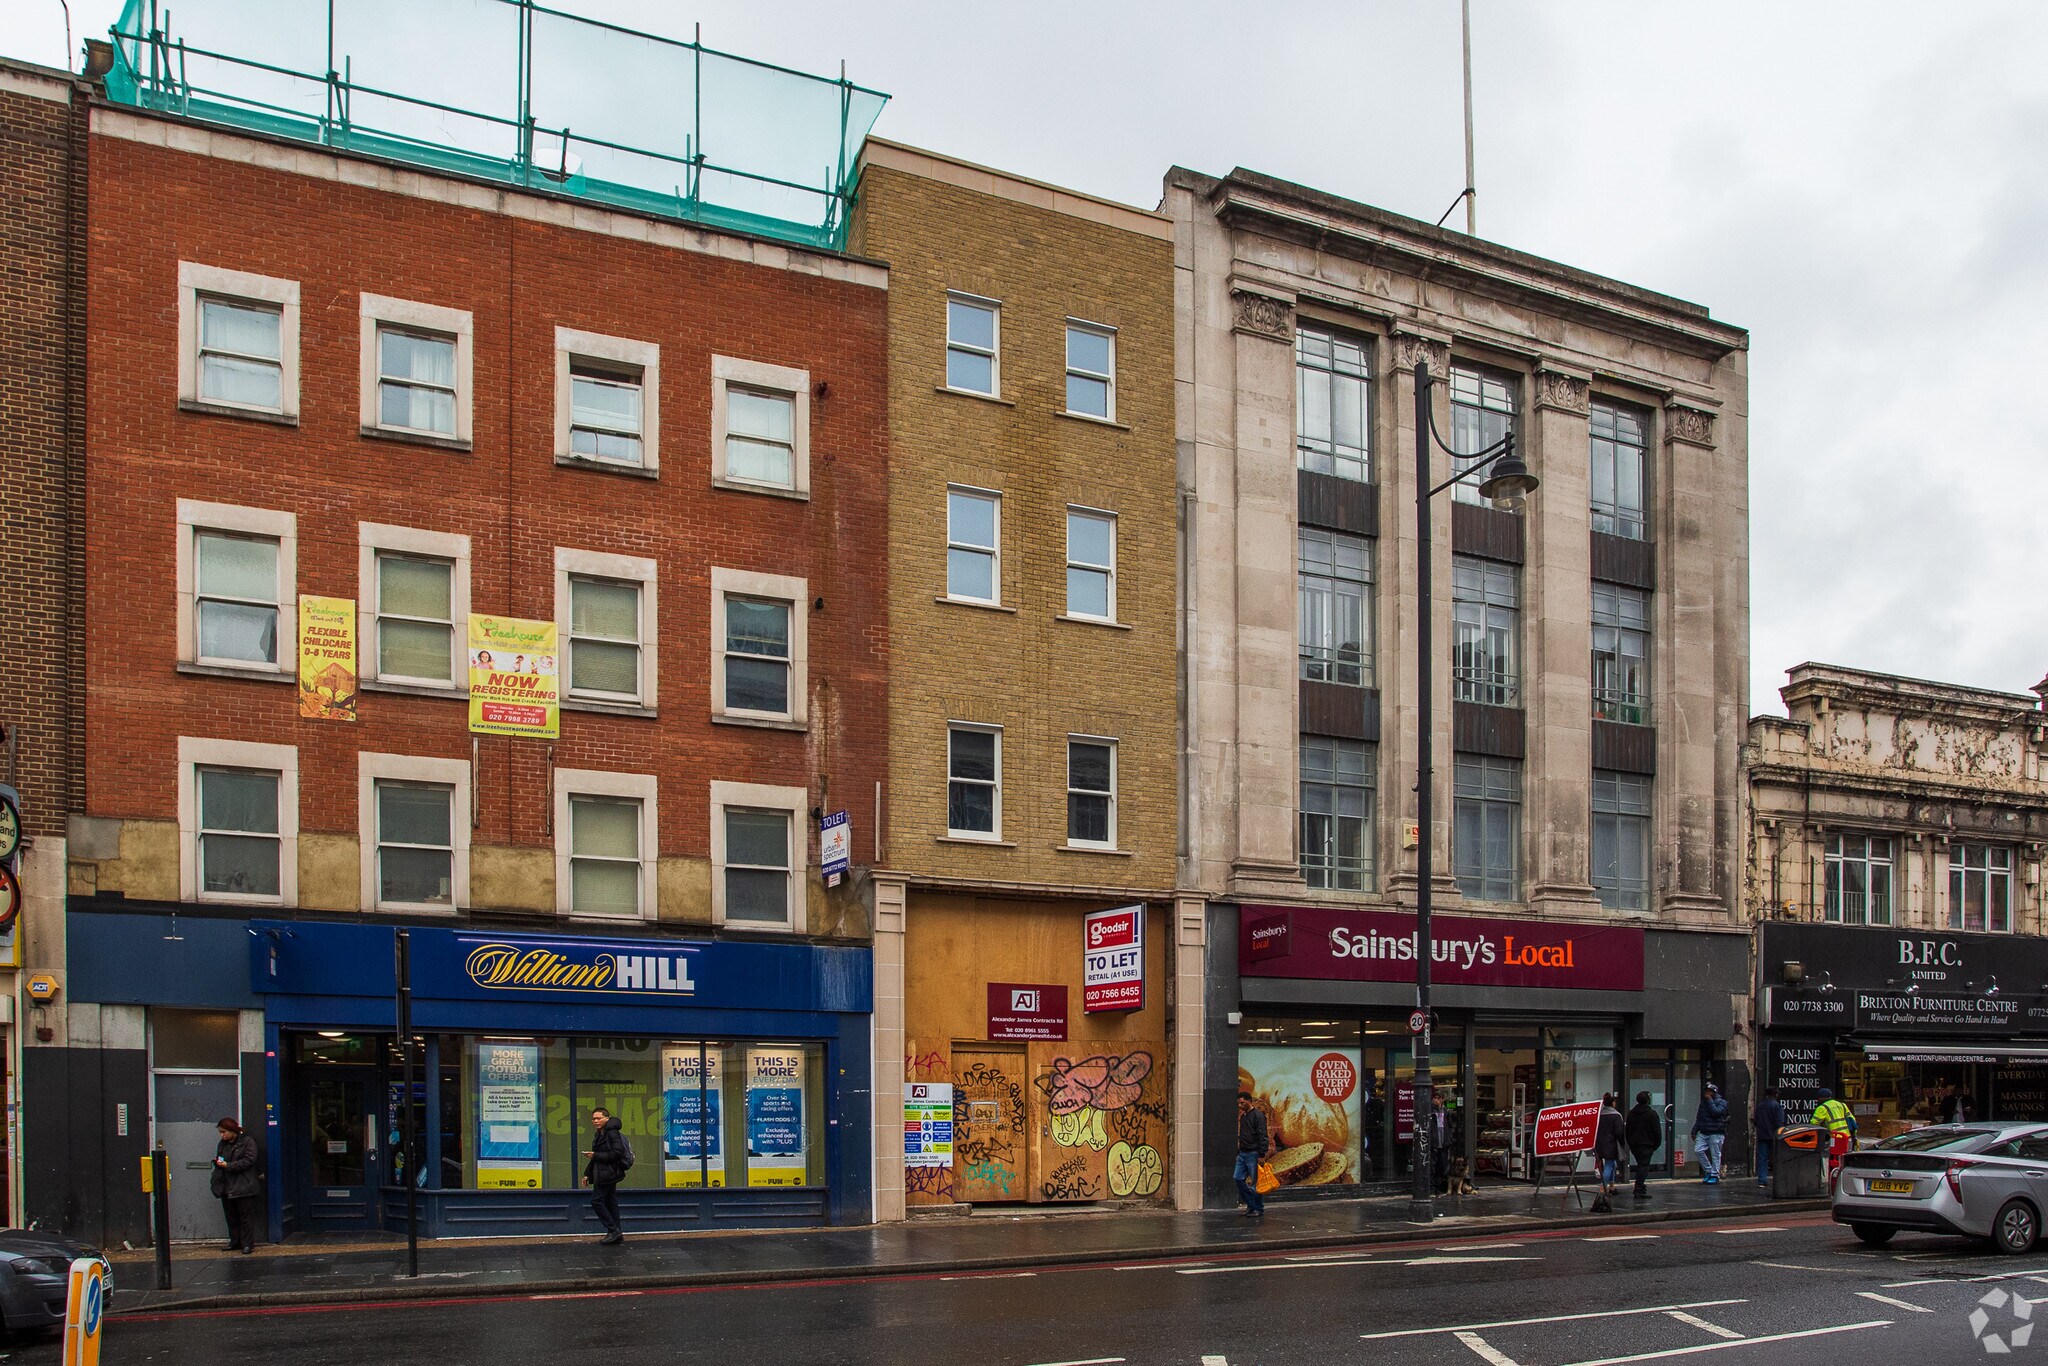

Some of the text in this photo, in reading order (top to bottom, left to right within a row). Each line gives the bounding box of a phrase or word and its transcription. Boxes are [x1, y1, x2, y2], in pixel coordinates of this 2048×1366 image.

[307, 626, 348, 638] FLEXIBLE
[303, 636, 352, 649] CHILDCARE
[304, 648, 351, 660] 0-6 YEARS
[488, 673, 540, 689] NOW
[471, 684, 557, 700] REGISTERING
[523, 716, 540, 724] 3789
[823, 812, 844, 828] TO LET
[1090, 920, 1129, 945] goodsir
[1252, 924, 1287, 940] Sainsbury's
[1252, 940, 1269, 950] Local
[1331, 927, 1574, 970] Sainsury's Local
[1898, 939, 1963, 967] B.F.C.
[1088, 952, 1137, 971] TO LET
[466, 944, 695, 991] William HILL
[1088, 969, 1138, 981] RETAIL (A1 USE)
[1911, 971, 1946, 981] LIMITED
[1086, 986, 1140, 1001] 020 7566 6455
[1014, 993, 1033, 1008] AJ
[1860, 995, 2018, 1013] BRIXTON FURNITURE CENTRE
[1783, 1000, 1844, 1013] 020 7738 3300
[1411, 1017, 1423, 1027] 20
[1870, 1012, 2008, 1024] Where Quality and Service Go Hand in Hand
[492, 1049, 524, 1058] MORE
[1779, 1048, 1820, 1060] ON-LINE
[1892, 1054, 1997, 1063] www.BRIXTONFURNITURECENTRE.com
[491, 1057, 526, 1066] GREAT
[669, 1057, 700, 1067] THIS
[753, 1056, 798, 1067] THIS IS
[1319, 1060, 1349, 1070] OVEN
[481, 1064, 535, 1074] FOOTBALL
[757, 1067, 795, 1077] MORE
[1316, 1069, 1352, 1079] BAKED
[1782, 1063, 1817, 1074] PRICES
[488, 1073, 529, 1081] OFFERS
[669, 1077, 697, 1085] EVERY
[782, 1076, 798, 1084] DAY
[1997, 1071, 2047, 1080] EVERYDAY
[1317, 1078, 1351, 1088] EVERY
[1779, 1077, 1820, 1088] IN-STORE
[914, 1087, 926, 1097] AJ
[1323, 1087, 1344, 1097] DAY
[2001, 1092, 2046, 1100] MASSIVE
[1780, 1099, 1801, 1110] BUY
[2002, 1102, 2045, 1111] SAVINGS
[1539, 1107, 1598, 1122] NARROW LANES
[1786, 1113, 1811, 1125] NOW
[1561, 1119, 1573, 1128] NO
[1543, 1127, 1590, 1139] OVERTAKING
[1548, 1137, 1583, 1148] CYCLISTS
[499, 1179, 516, 1187] FUN
[1892, 1182, 1909, 1190] YVG
